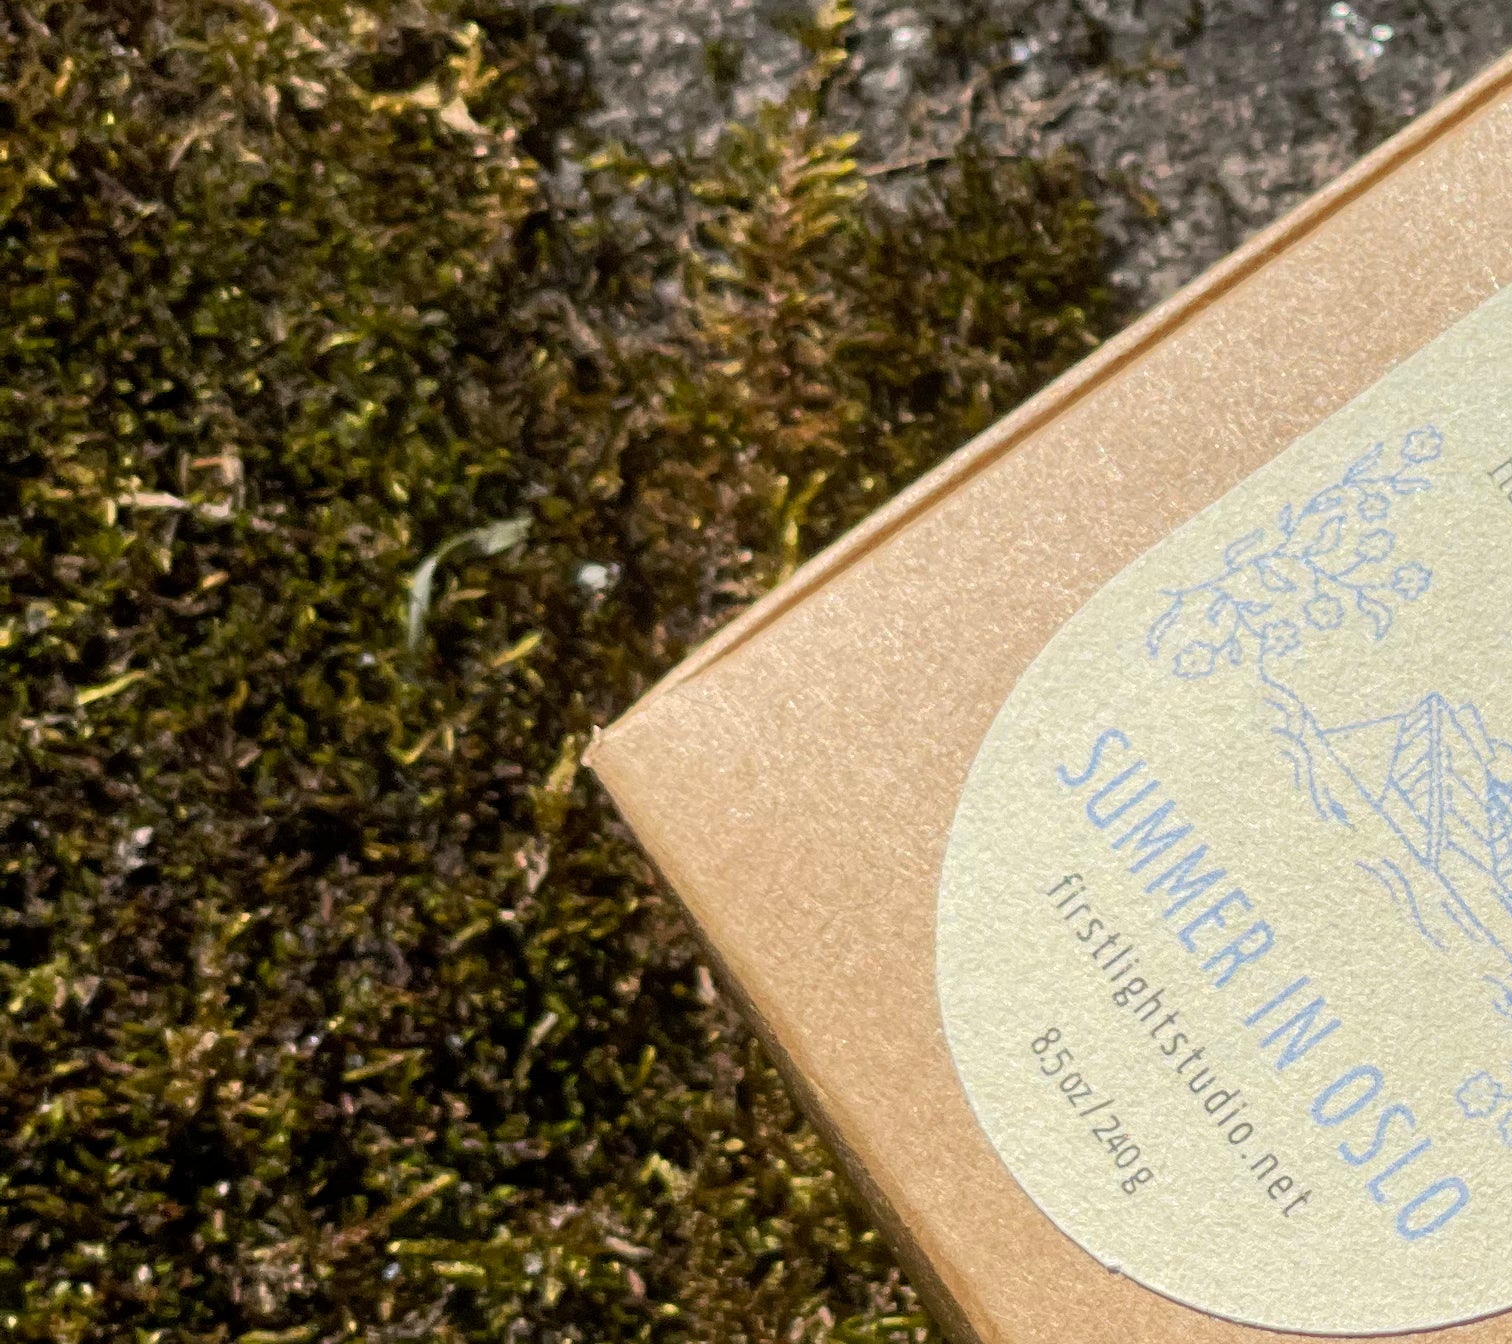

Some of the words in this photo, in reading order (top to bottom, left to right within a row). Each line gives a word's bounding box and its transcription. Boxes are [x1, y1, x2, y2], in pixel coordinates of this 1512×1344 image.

[1047, 873, 1313, 1218] firstlightstudio.net
[1057, 727, 1275, 988] SUMMER
[1244, 976, 1342, 1072] IN
[1310, 1064, 1469, 1241] OSLO
